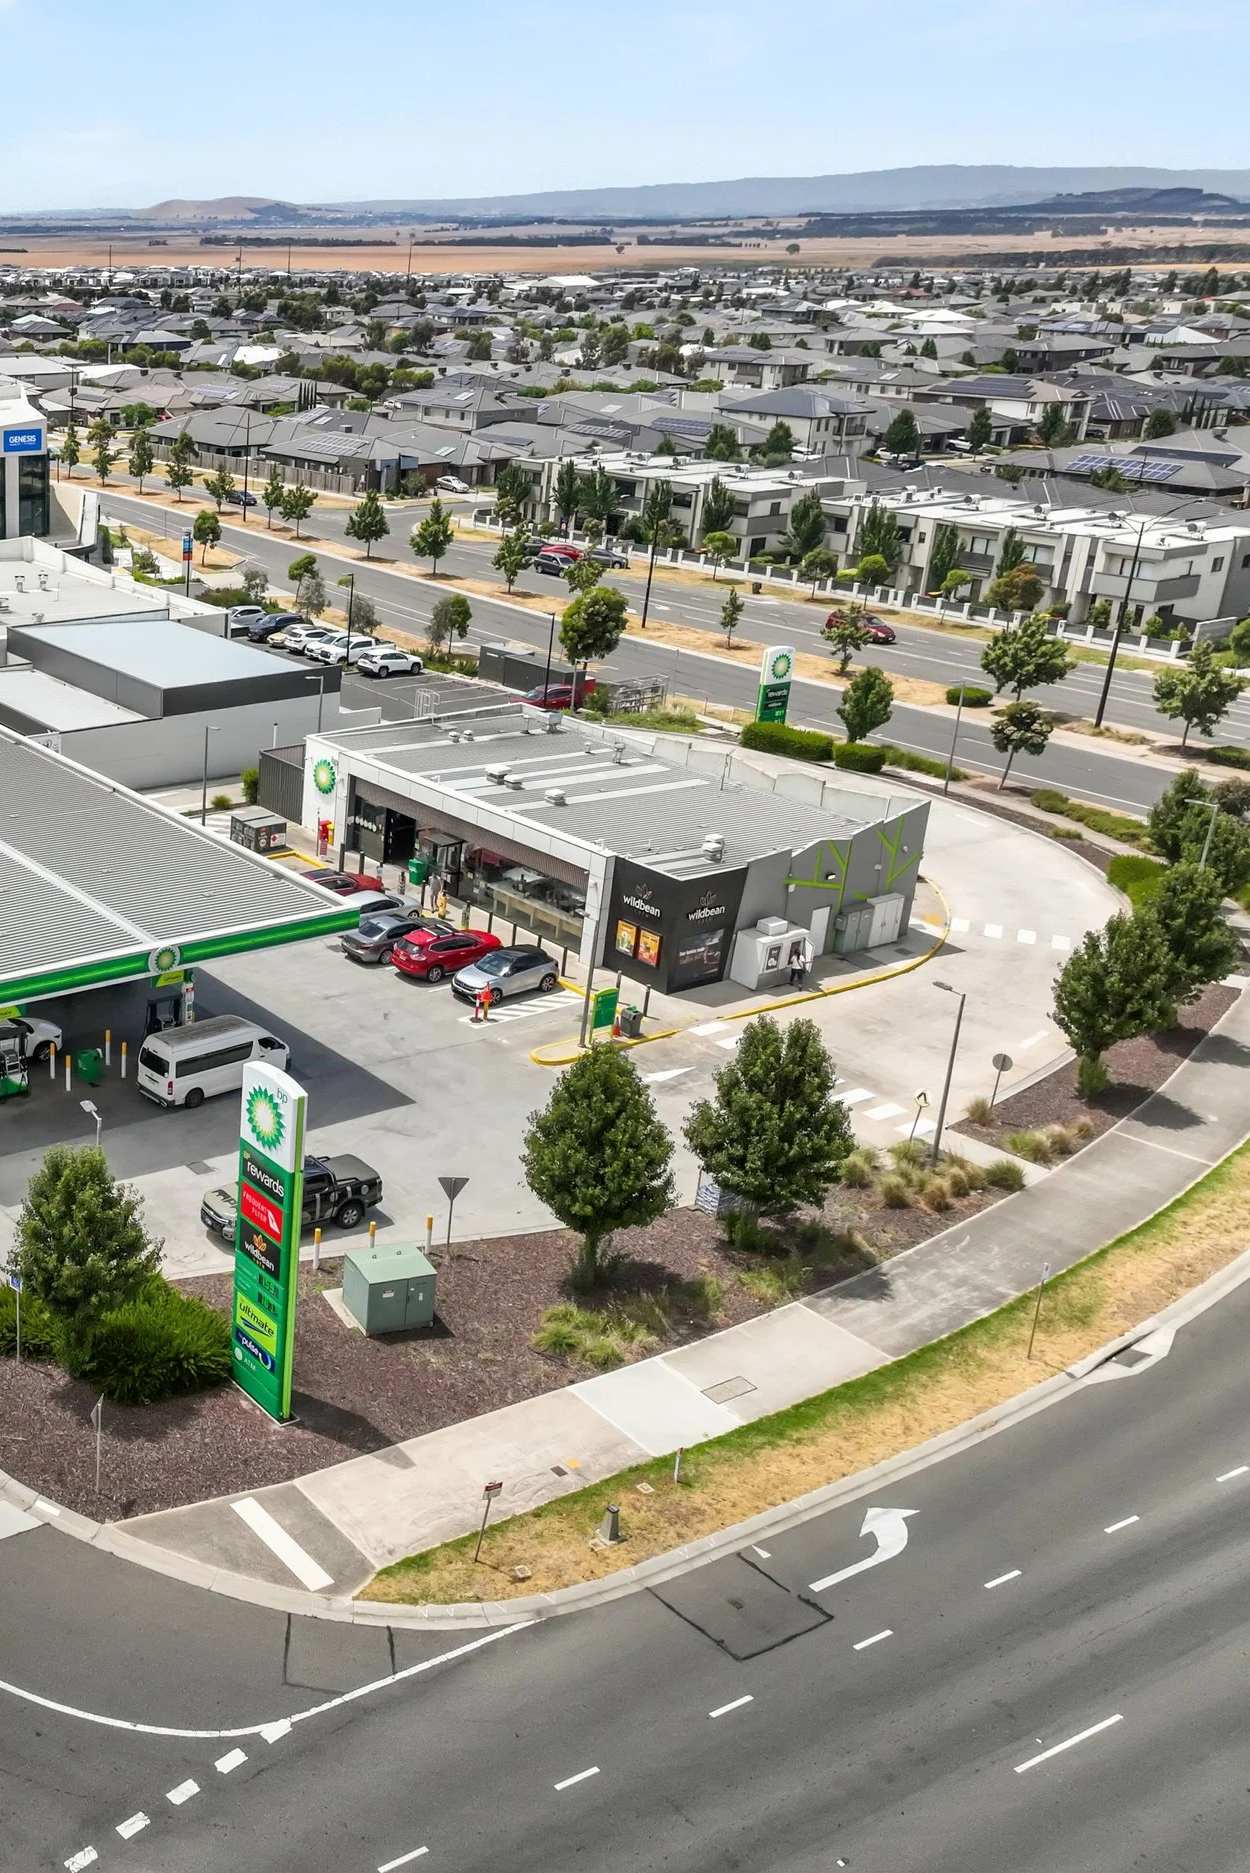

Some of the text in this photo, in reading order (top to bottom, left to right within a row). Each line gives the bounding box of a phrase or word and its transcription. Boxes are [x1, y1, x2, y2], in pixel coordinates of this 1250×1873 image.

[9, 435, 37, 443] GENESIS
[623, 895, 660, 917] wildbean
[688, 905, 725, 920] wildbean
[276, 1087, 288, 1104] bp
[247, 1161, 284, 1197] rewards
[242, 1190, 268, 1214] FREQUENT
[244, 1240, 275, 1272] wildbean
[239, 1302, 275, 1336] ultimate
[241, 1336, 259, 1356] pulse
